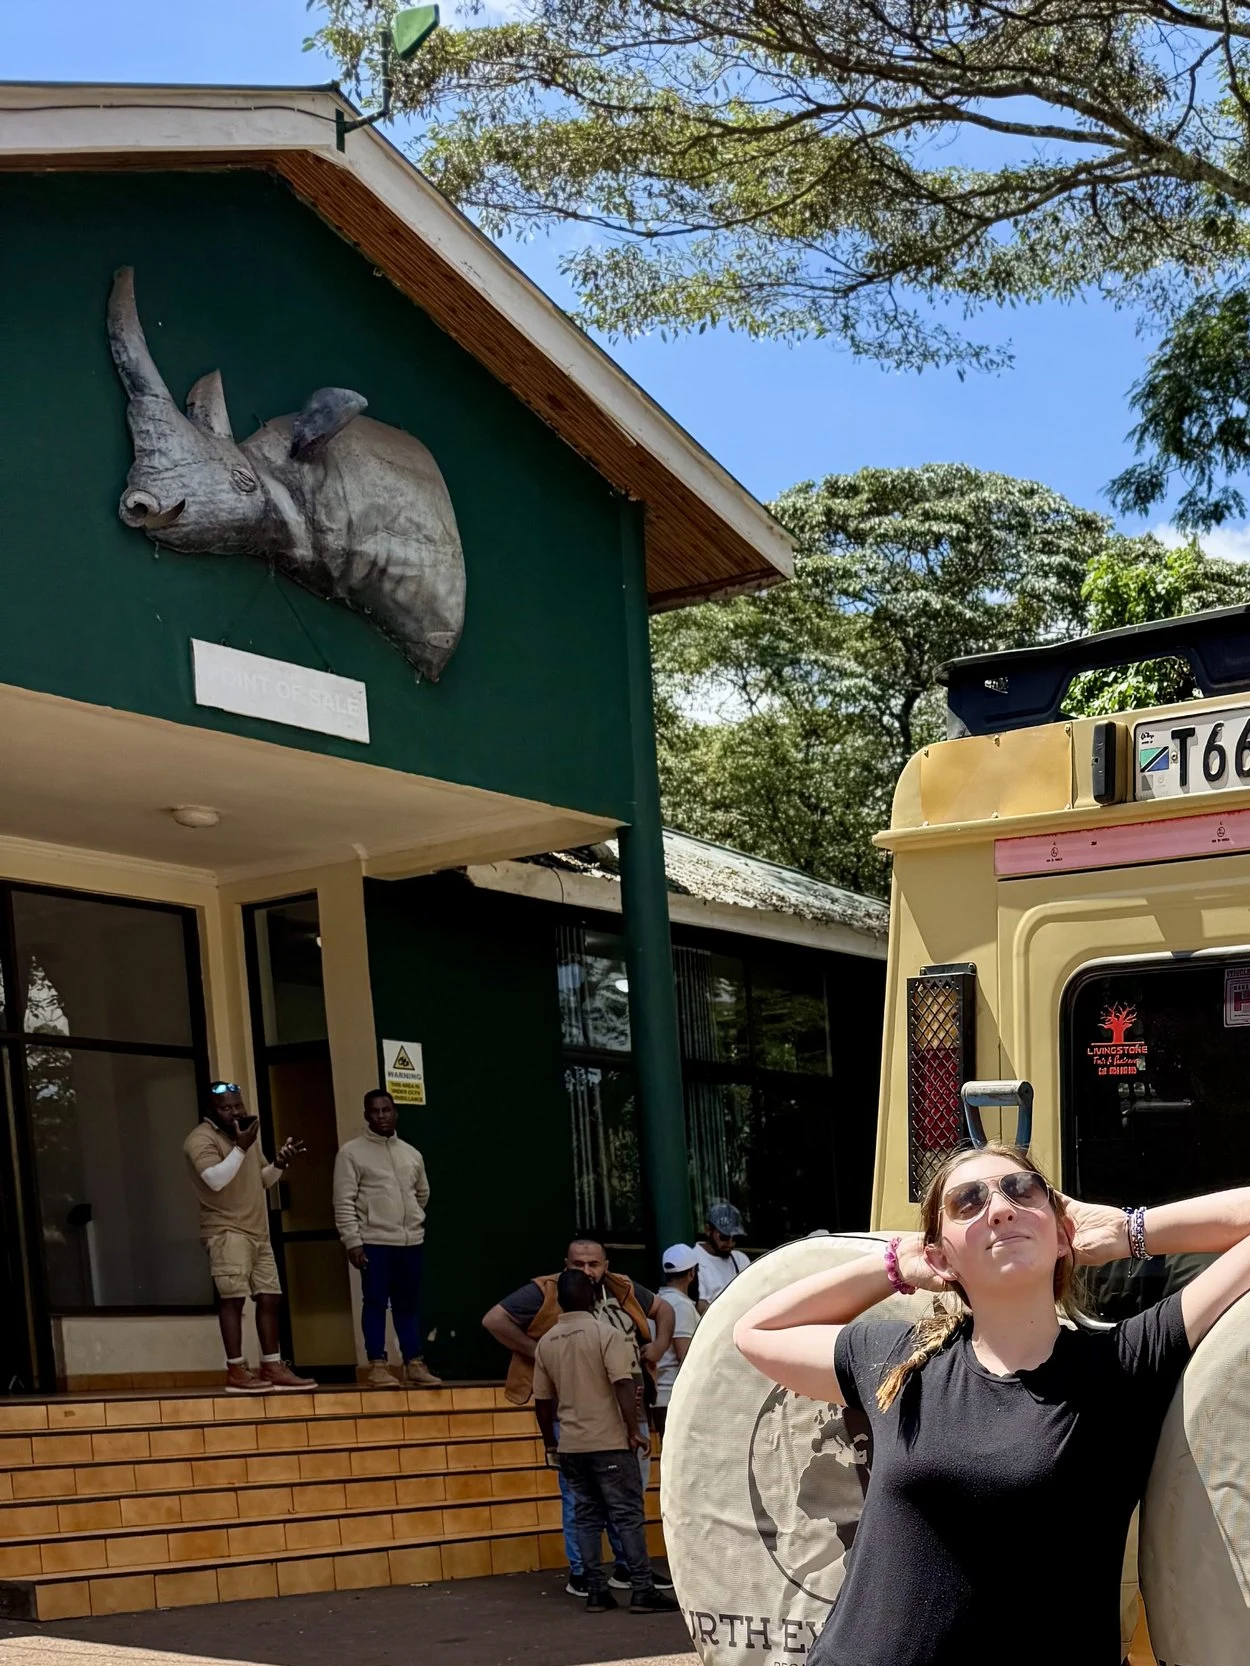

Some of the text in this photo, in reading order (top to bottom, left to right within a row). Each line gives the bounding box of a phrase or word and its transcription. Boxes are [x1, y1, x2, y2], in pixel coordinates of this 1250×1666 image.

[208, 661, 361, 717] POINT OF SALE
[1087, 1045, 1148, 1055] LIVINGSTONE
[387, 1072, 422, 1080] WARNING
